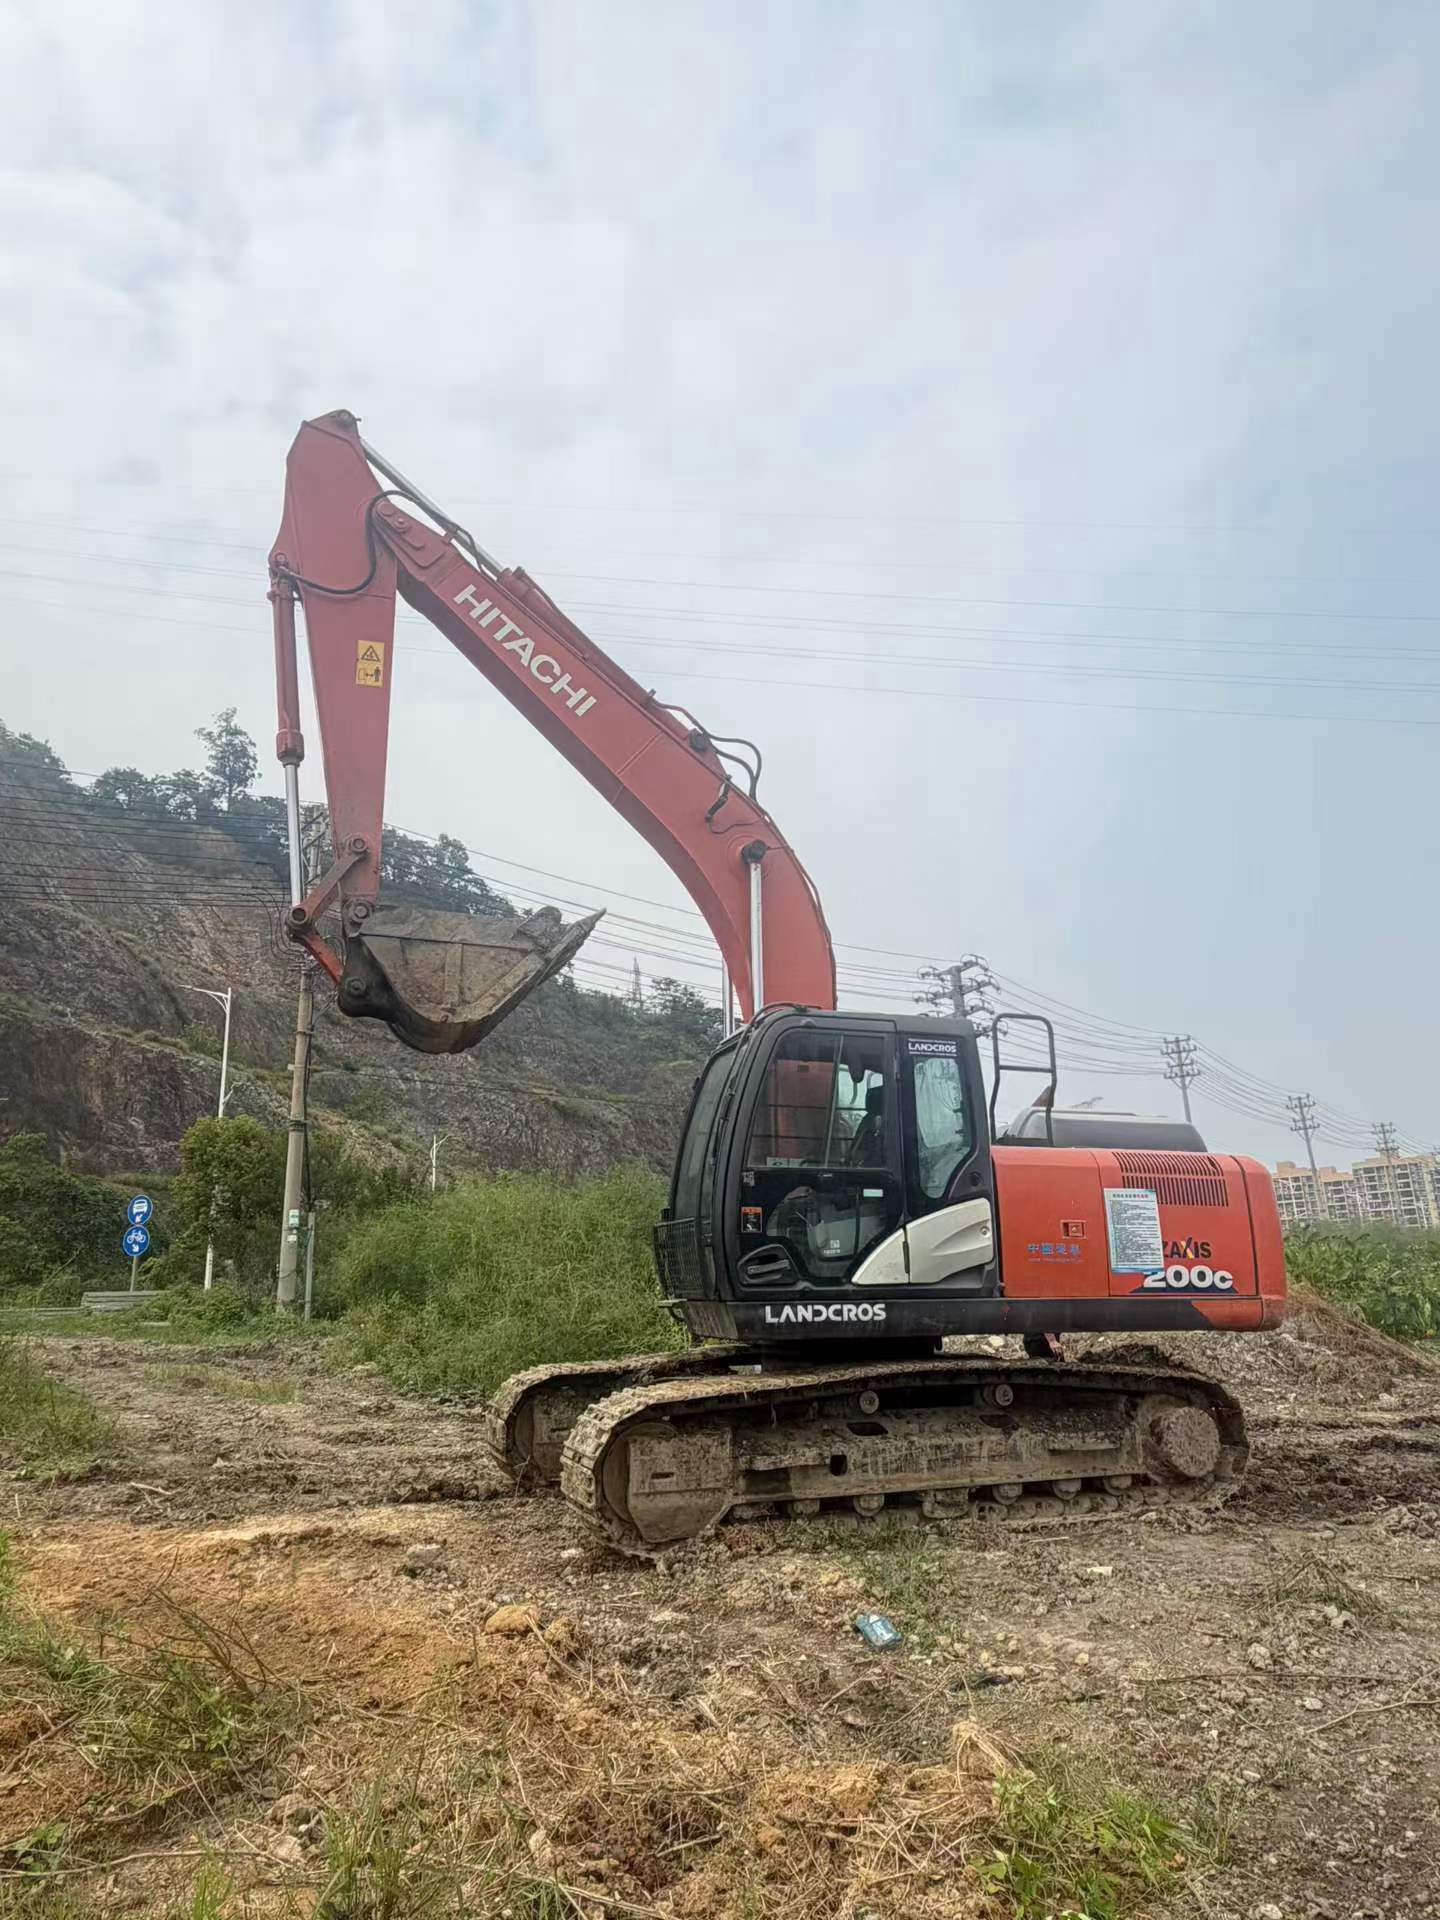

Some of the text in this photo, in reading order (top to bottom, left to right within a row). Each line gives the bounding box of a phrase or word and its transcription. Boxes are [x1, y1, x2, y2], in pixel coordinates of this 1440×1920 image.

[453, 584, 598, 717] HITACHI
[908, 1042, 957, 1053] LANDCROS
[765, 1303, 887, 1323] LANDCROS
